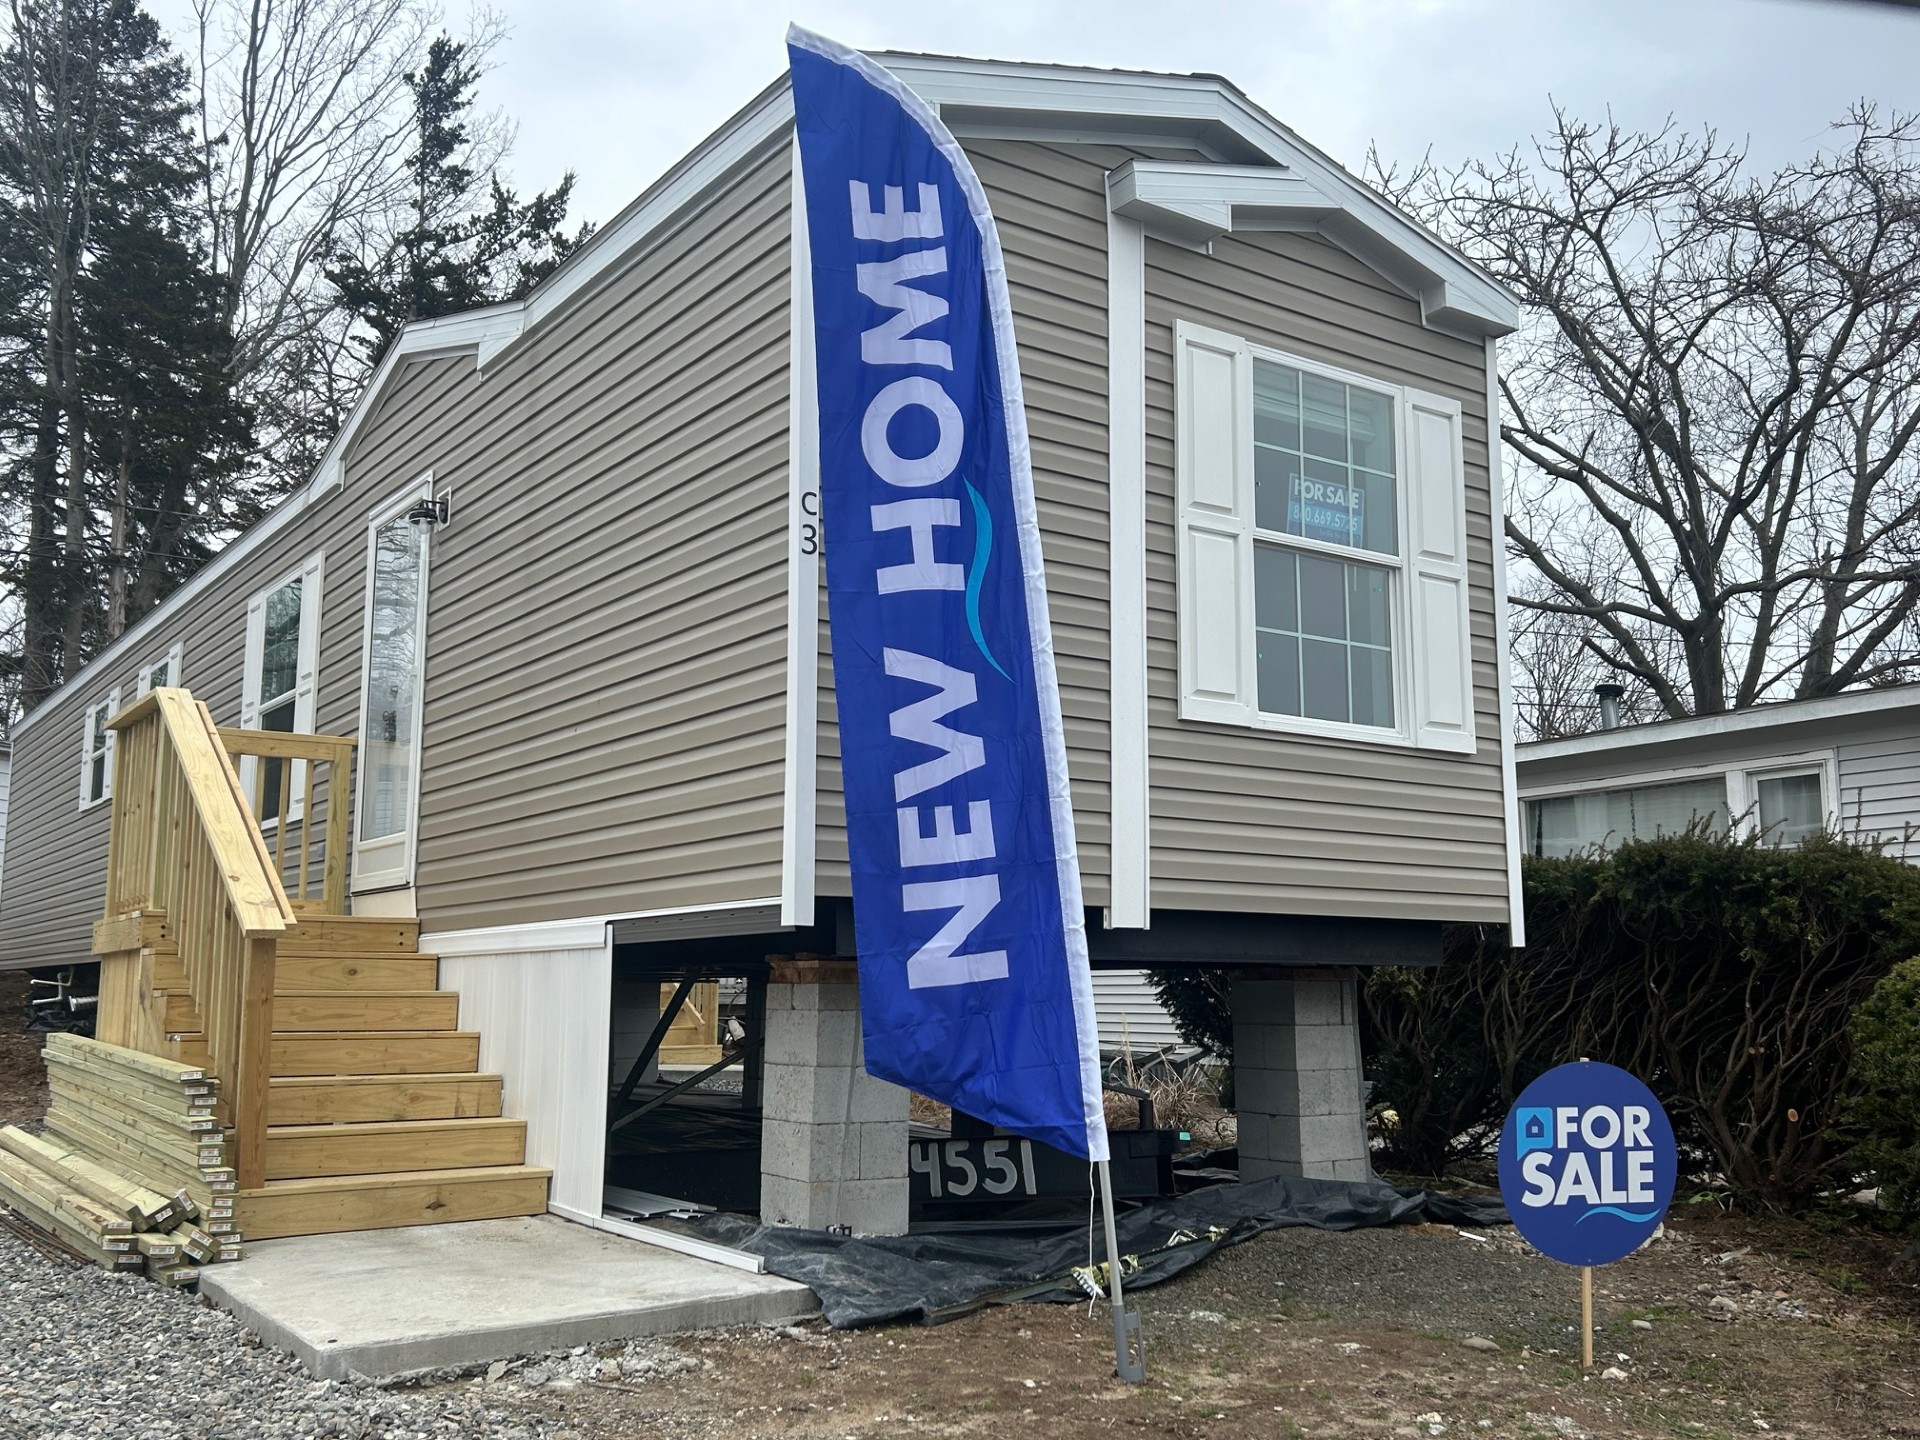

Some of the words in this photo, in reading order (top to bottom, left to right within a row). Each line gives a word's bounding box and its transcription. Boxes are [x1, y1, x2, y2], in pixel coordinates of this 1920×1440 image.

[849, 179, 966, 596] HOME
[801, 491, 818, 516] C
[1294, 479, 1324, 502] FOR
[801, 523, 818, 555] 3
[1293, 505, 1358, 531] 80.669.575
[883, 646, 1009, 990] NEW
[1556, 1104, 1654, 1149] FOR
[910, 1139, 1038, 1198] 4551
[1521, 1150, 1655, 1208] SALE
